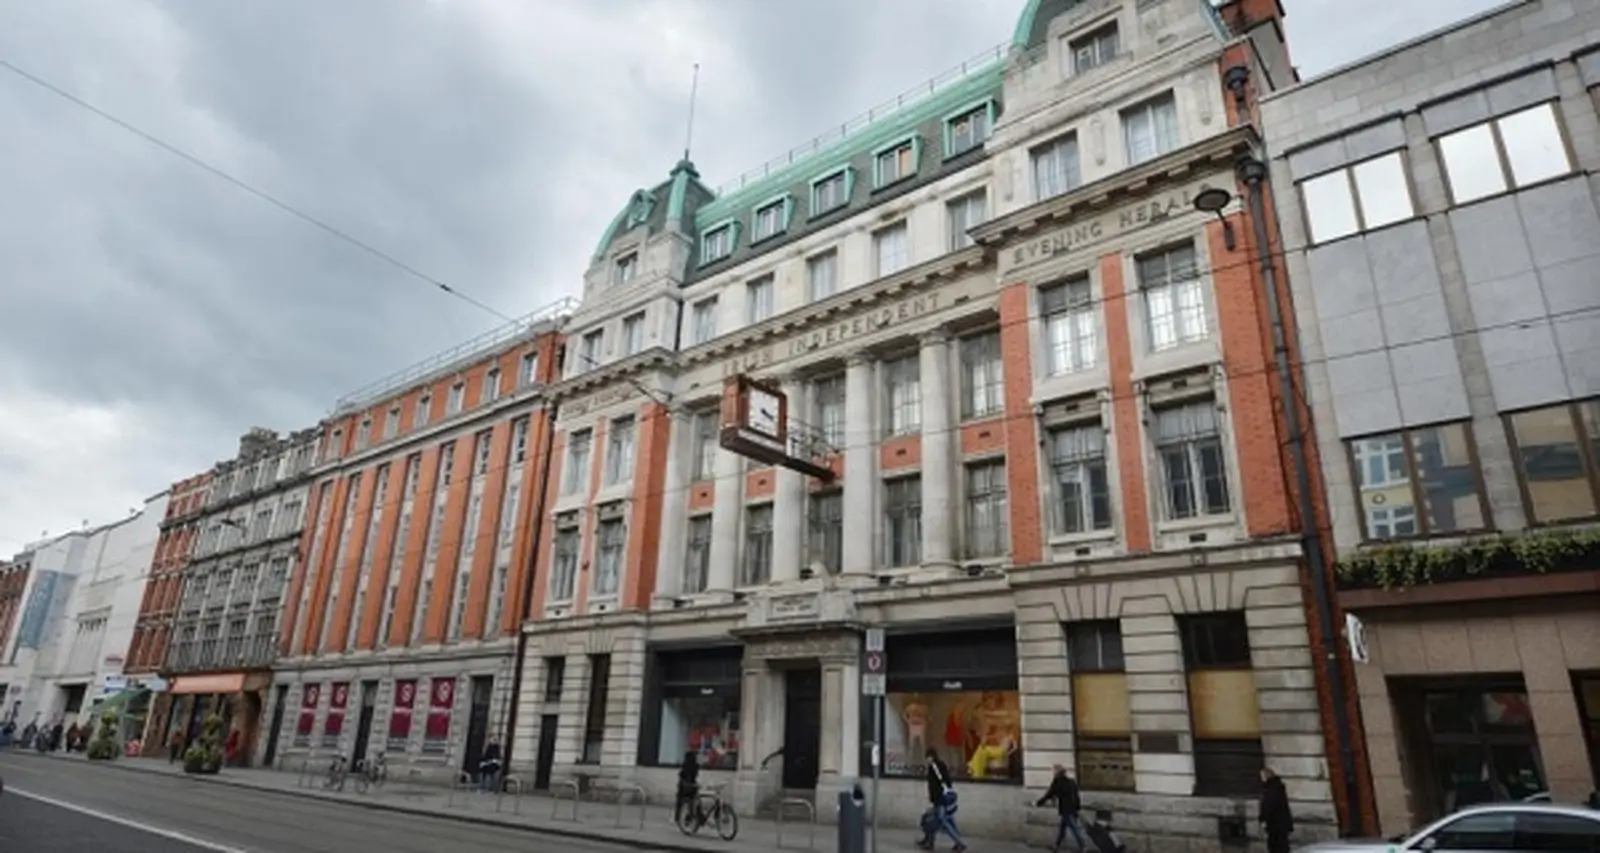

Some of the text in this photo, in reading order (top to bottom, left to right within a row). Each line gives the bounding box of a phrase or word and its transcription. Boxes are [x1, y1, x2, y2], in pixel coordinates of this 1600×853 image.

[1012, 183, 1211, 264] EVENING HERAL
[788, 292, 940, 355] INDEPENDENT
